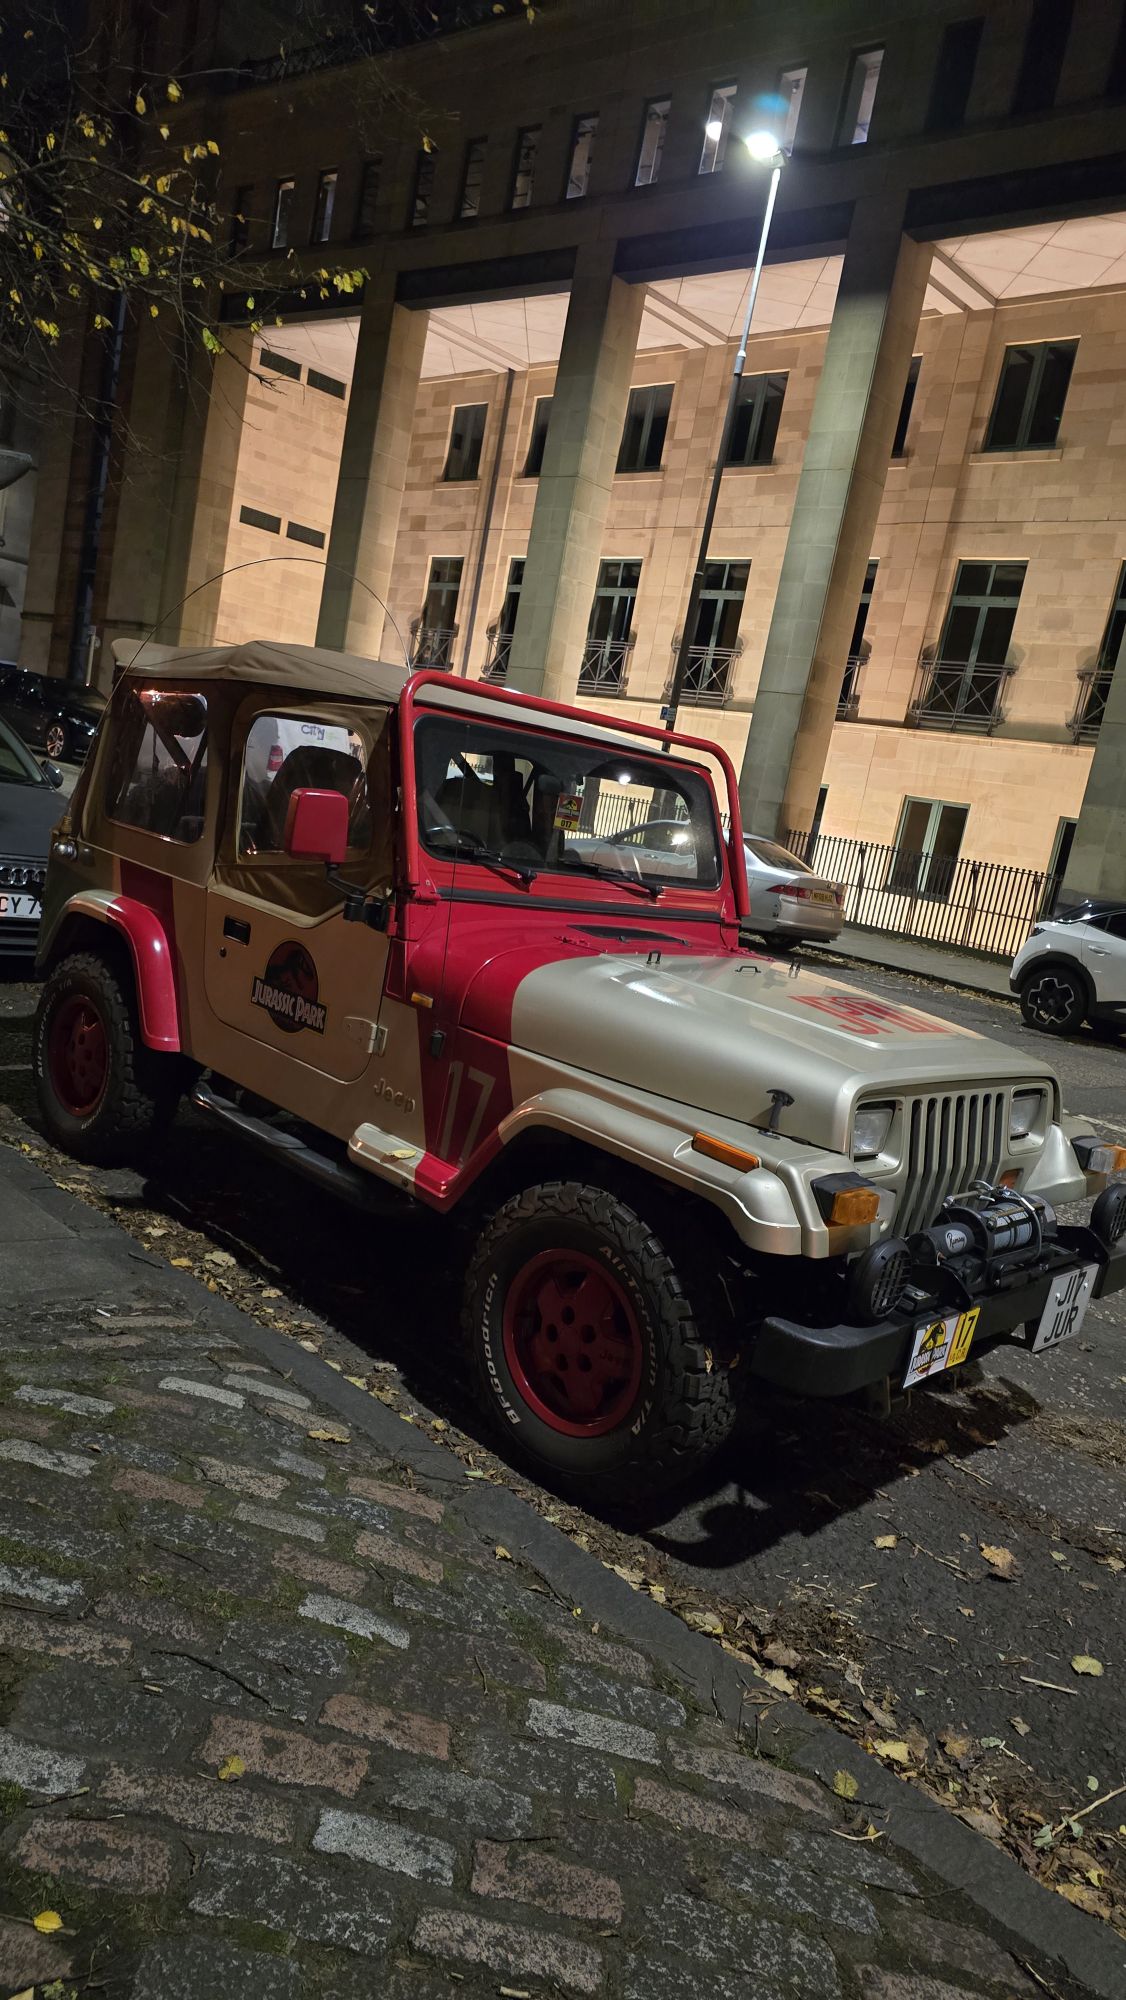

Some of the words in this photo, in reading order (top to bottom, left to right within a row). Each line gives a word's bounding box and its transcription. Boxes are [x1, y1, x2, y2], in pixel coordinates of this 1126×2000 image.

[28, 897, 42, 914] 7
[295, 996, 325, 1029] PARK
[373, 1078, 416, 1114] Jeep
[440, 1060, 496, 1168] 17
[1057, 1271, 1087, 1306] J17
[956, 1312, 976, 1349] 17
[1044, 1306, 1078, 1343] JUR
